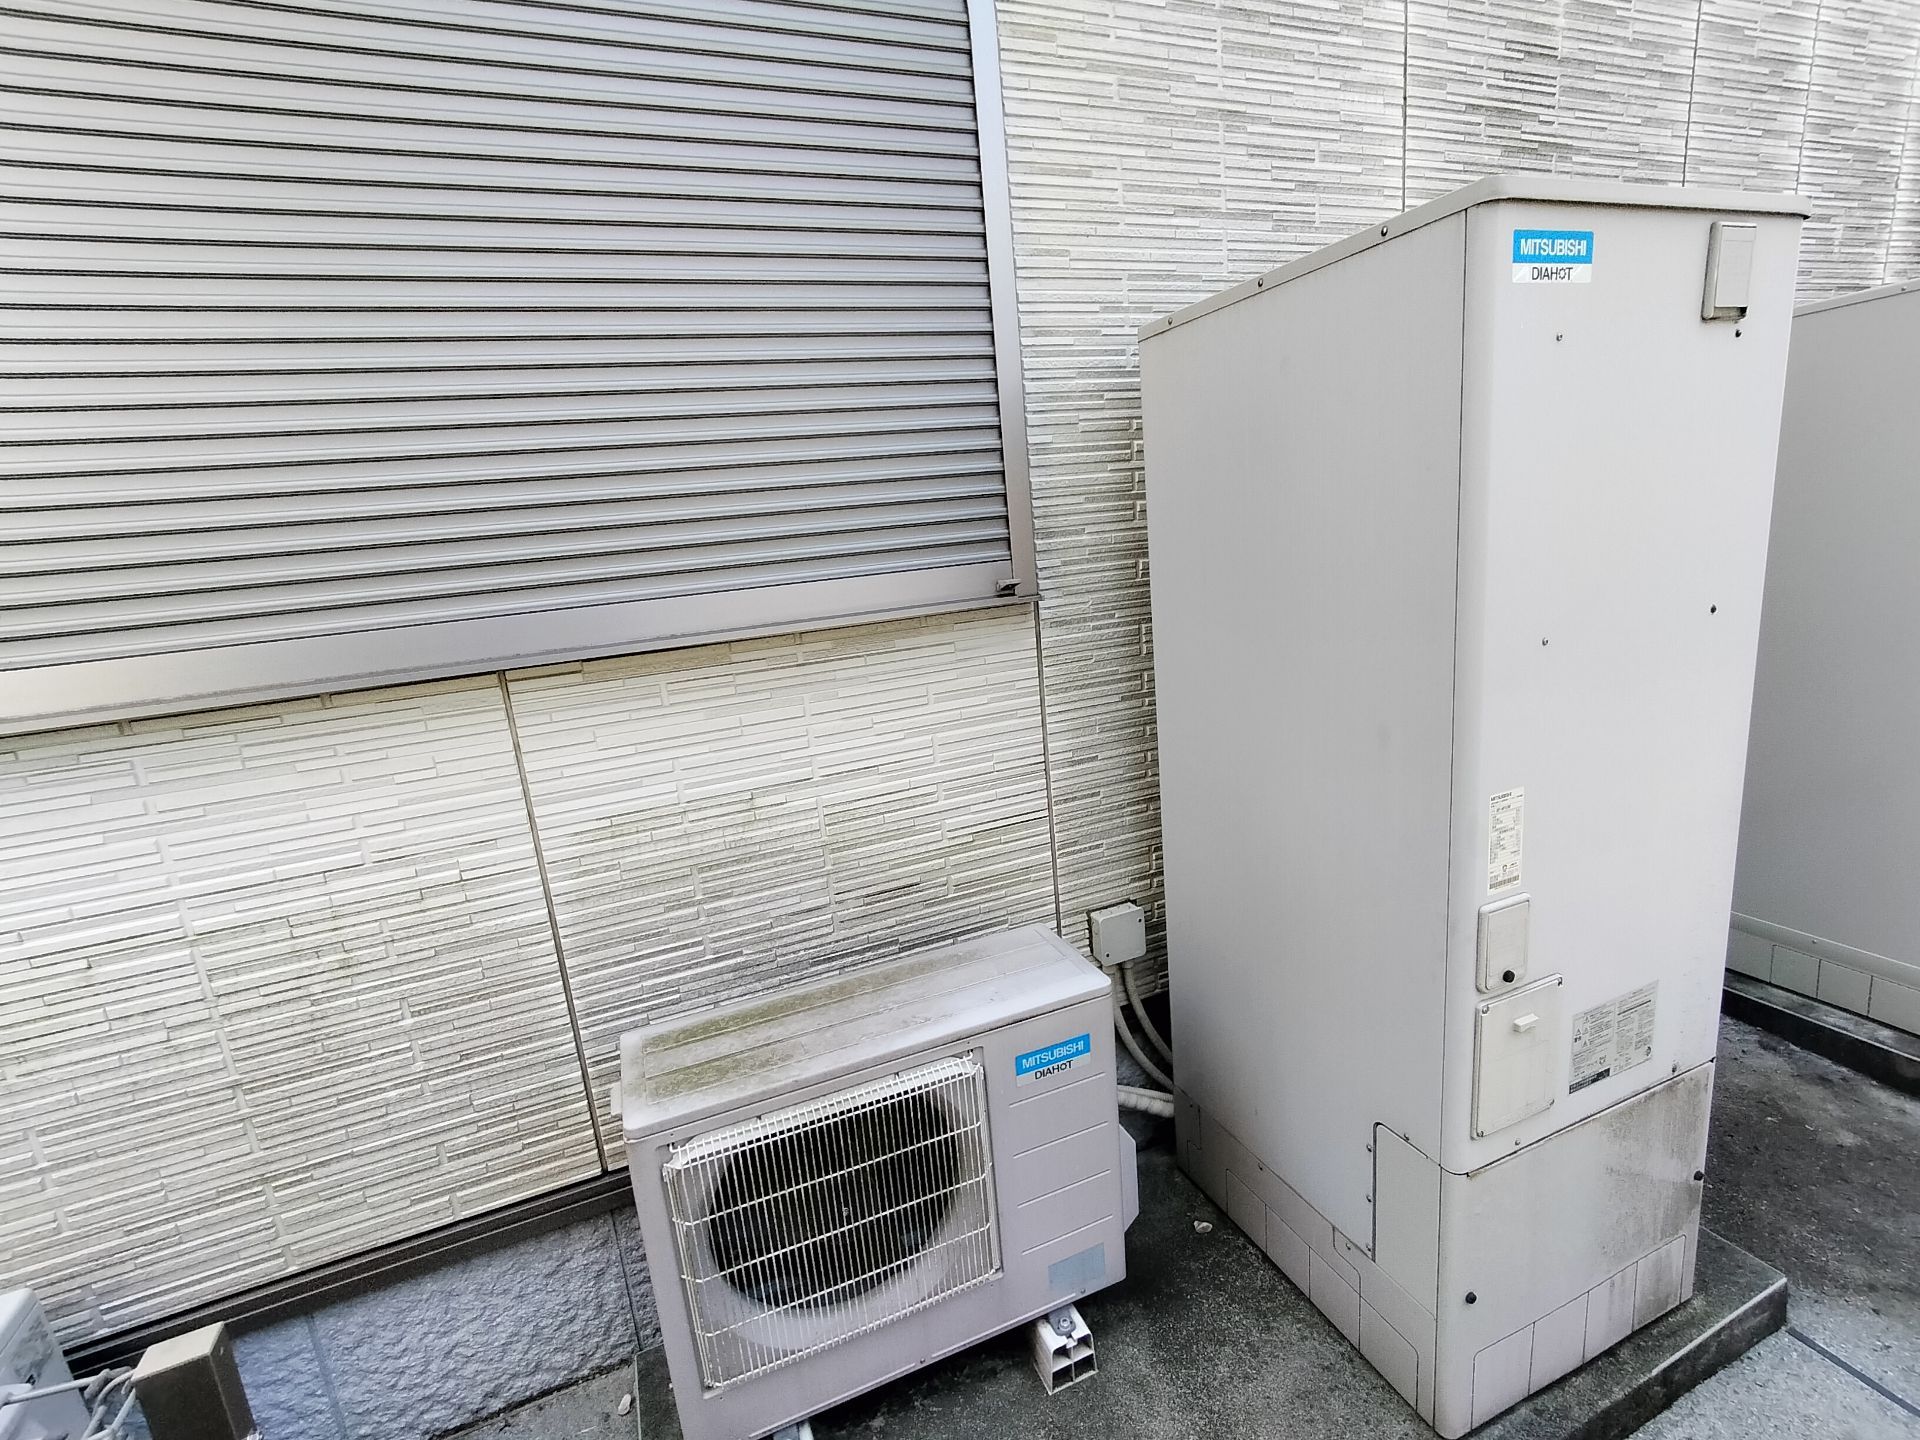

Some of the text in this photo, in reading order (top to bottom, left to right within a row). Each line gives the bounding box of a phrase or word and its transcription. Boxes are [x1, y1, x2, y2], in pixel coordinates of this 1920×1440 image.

[1520, 238, 1587, 256] MITSUBISHI
[1531, 266, 1574, 281] DIAHOT
[1022, 1040, 1084, 1069] MITSUBISHI
[1034, 1060, 1074, 1080] DIAHOT
